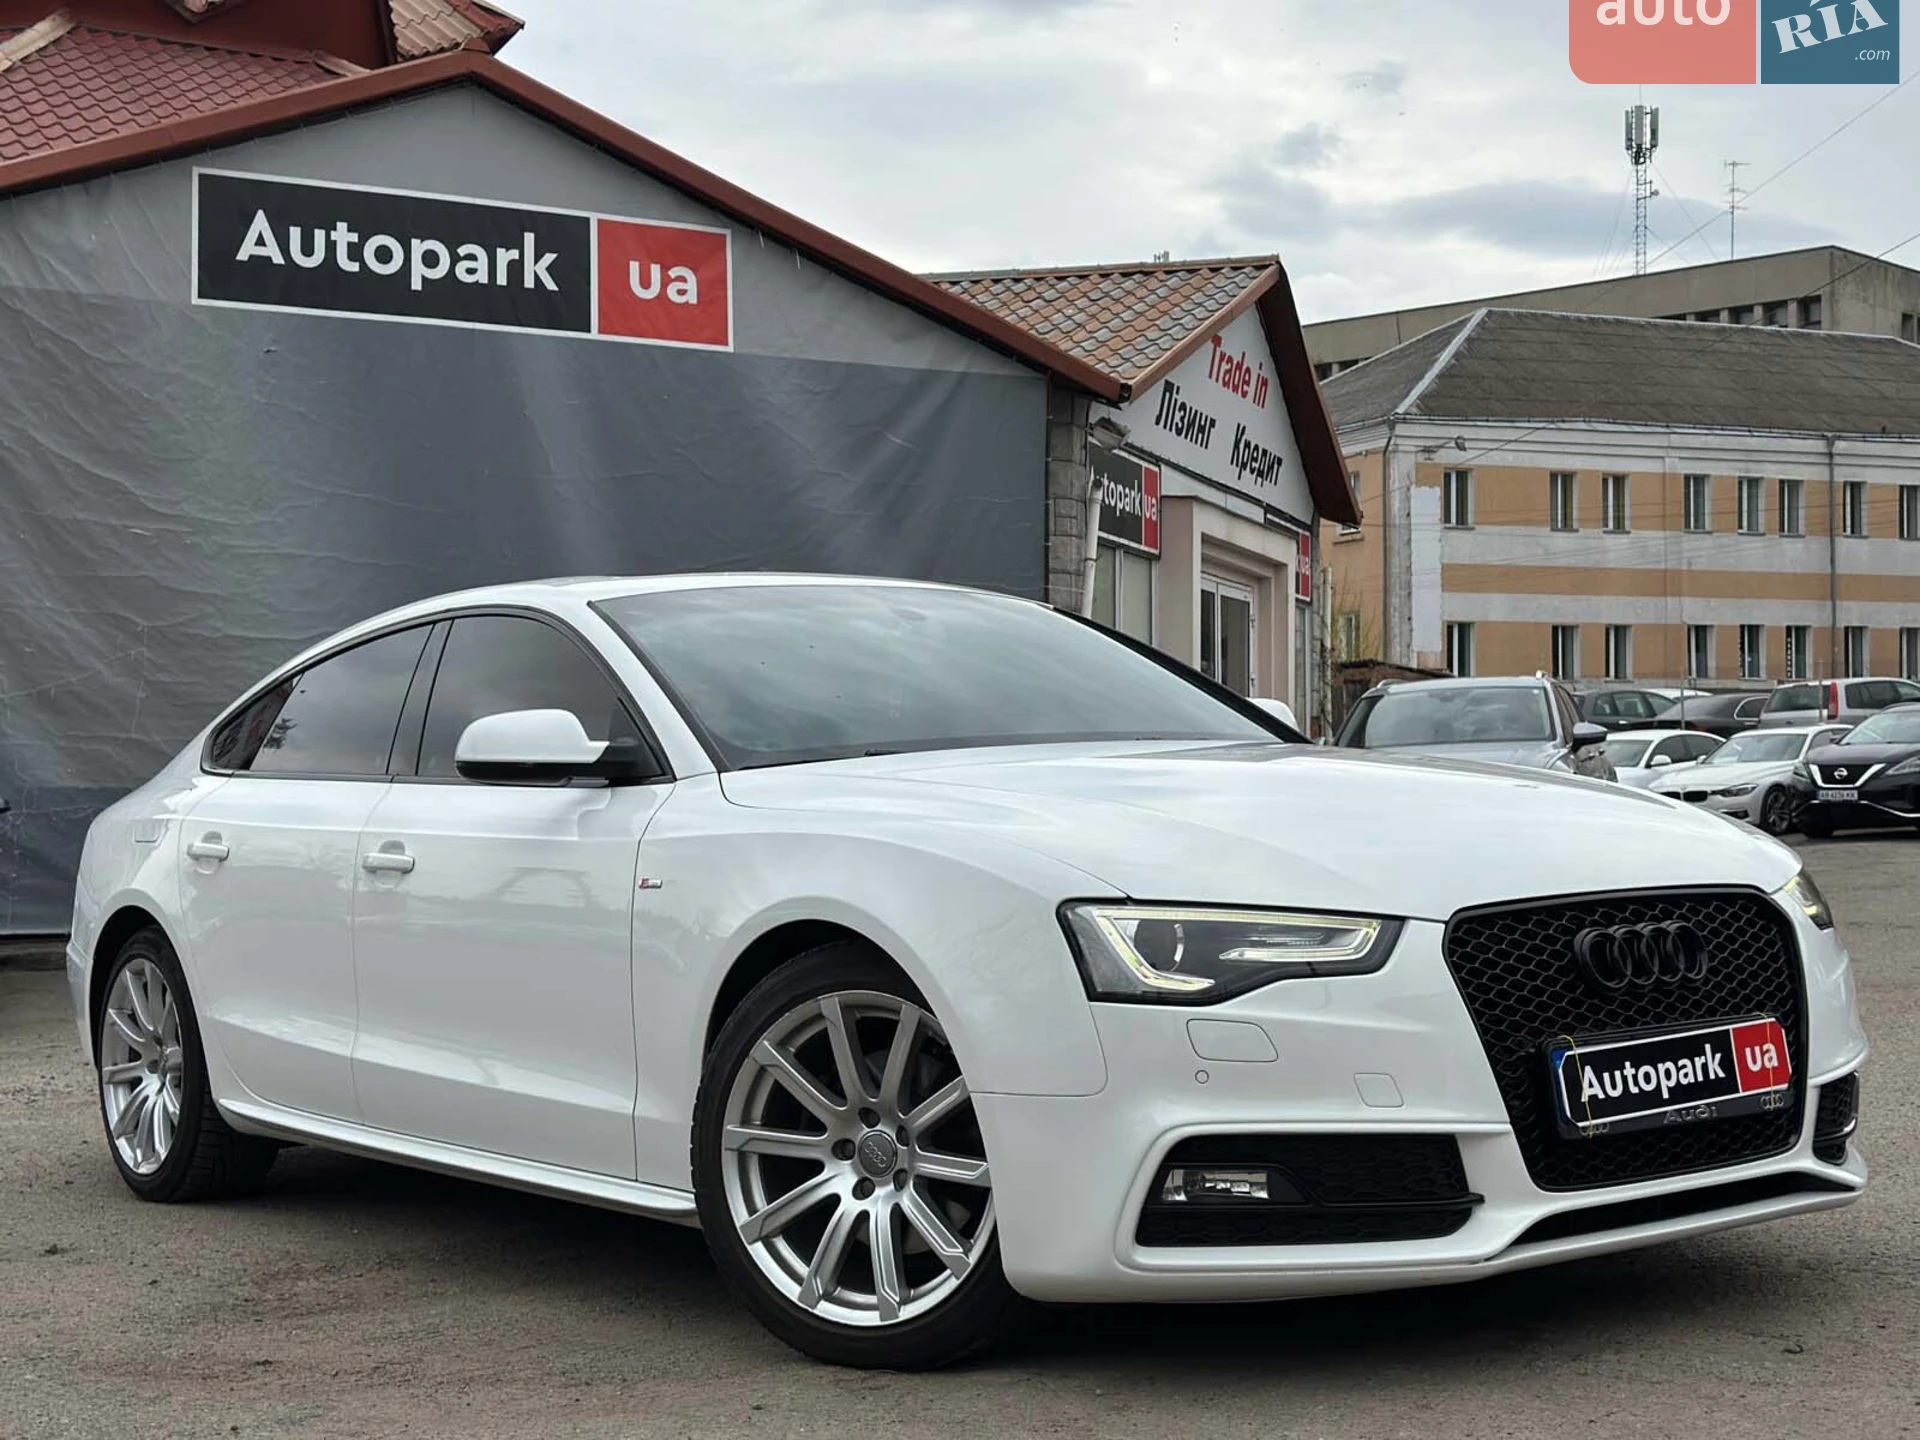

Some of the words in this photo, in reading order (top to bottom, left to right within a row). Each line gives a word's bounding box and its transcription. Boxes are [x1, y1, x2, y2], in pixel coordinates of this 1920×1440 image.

[235, 208, 559, 292] Autopark
[628, 259, 698, 305] ua
[1208, 333, 1252, 399] Trade
[1253, 361, 1269, 410] in
[1154, 378, 1217, 449] Лізинг
[1230, 422, 1283, 488] Кредит
[1144, 493, 1158, 521] ua
[1581, 1043, 1726, 1102] Autopark
[1745, 1042, 1779, 1073] ua
[1663, 1104, 1717, 1124] Audi
